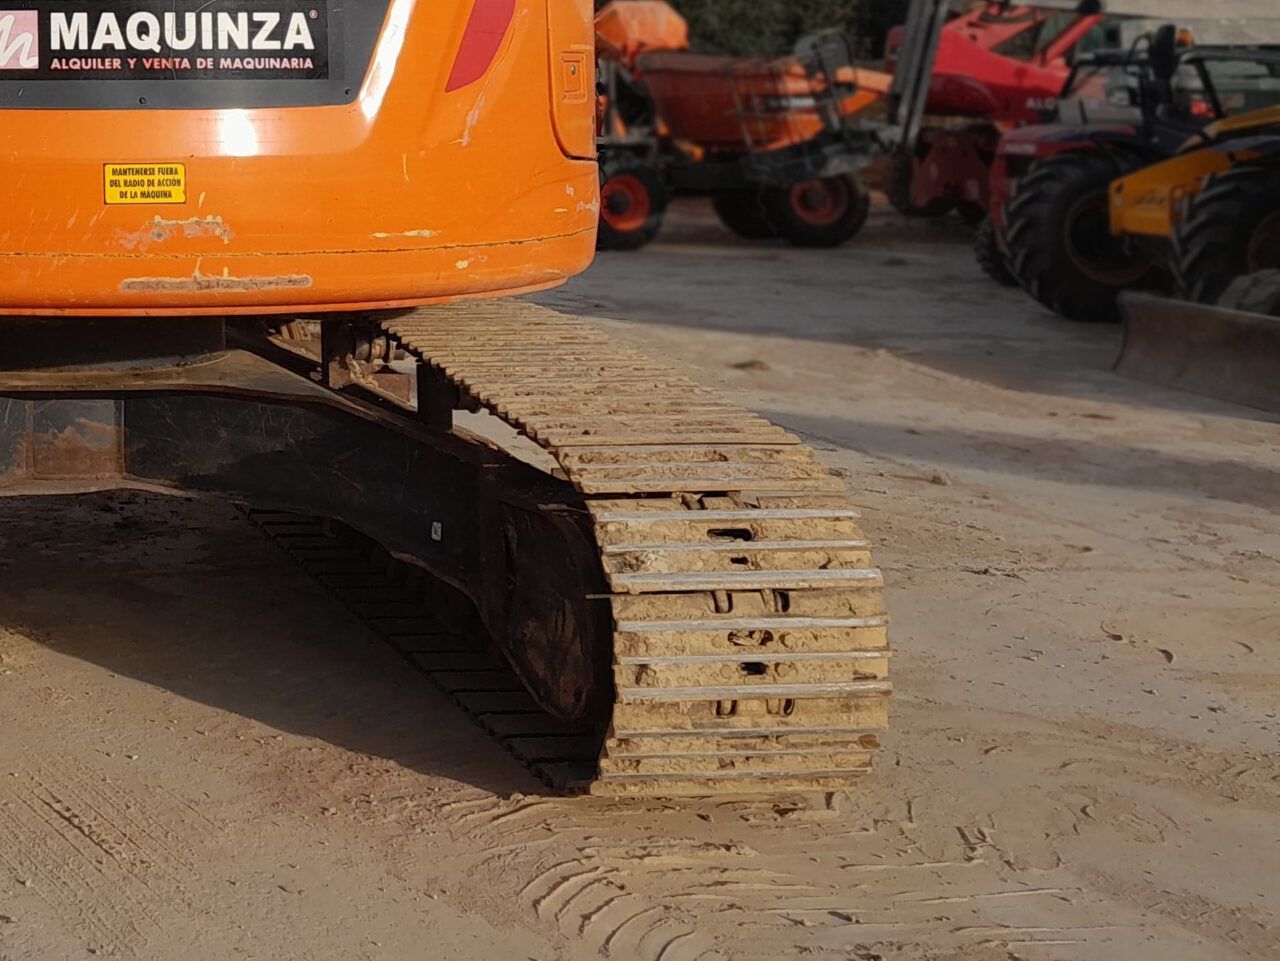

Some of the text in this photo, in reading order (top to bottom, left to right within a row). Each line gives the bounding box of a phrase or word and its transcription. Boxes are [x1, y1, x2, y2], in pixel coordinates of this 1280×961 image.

[50, 12, 315, 53] MAQUINZA
[51, 58, 314, 71] ALQUILER Y VENTA DE MAQUINARIA
[112, 167, 178, 176] MANTENERSE FUERA
[110, 179, 121, 187] DEL
[124, 179, 145, 187] RADIO
[147, 179, 155, 187] DE
[120, 191, 128, 199] DE
[130, 191, 138, 199] LA
